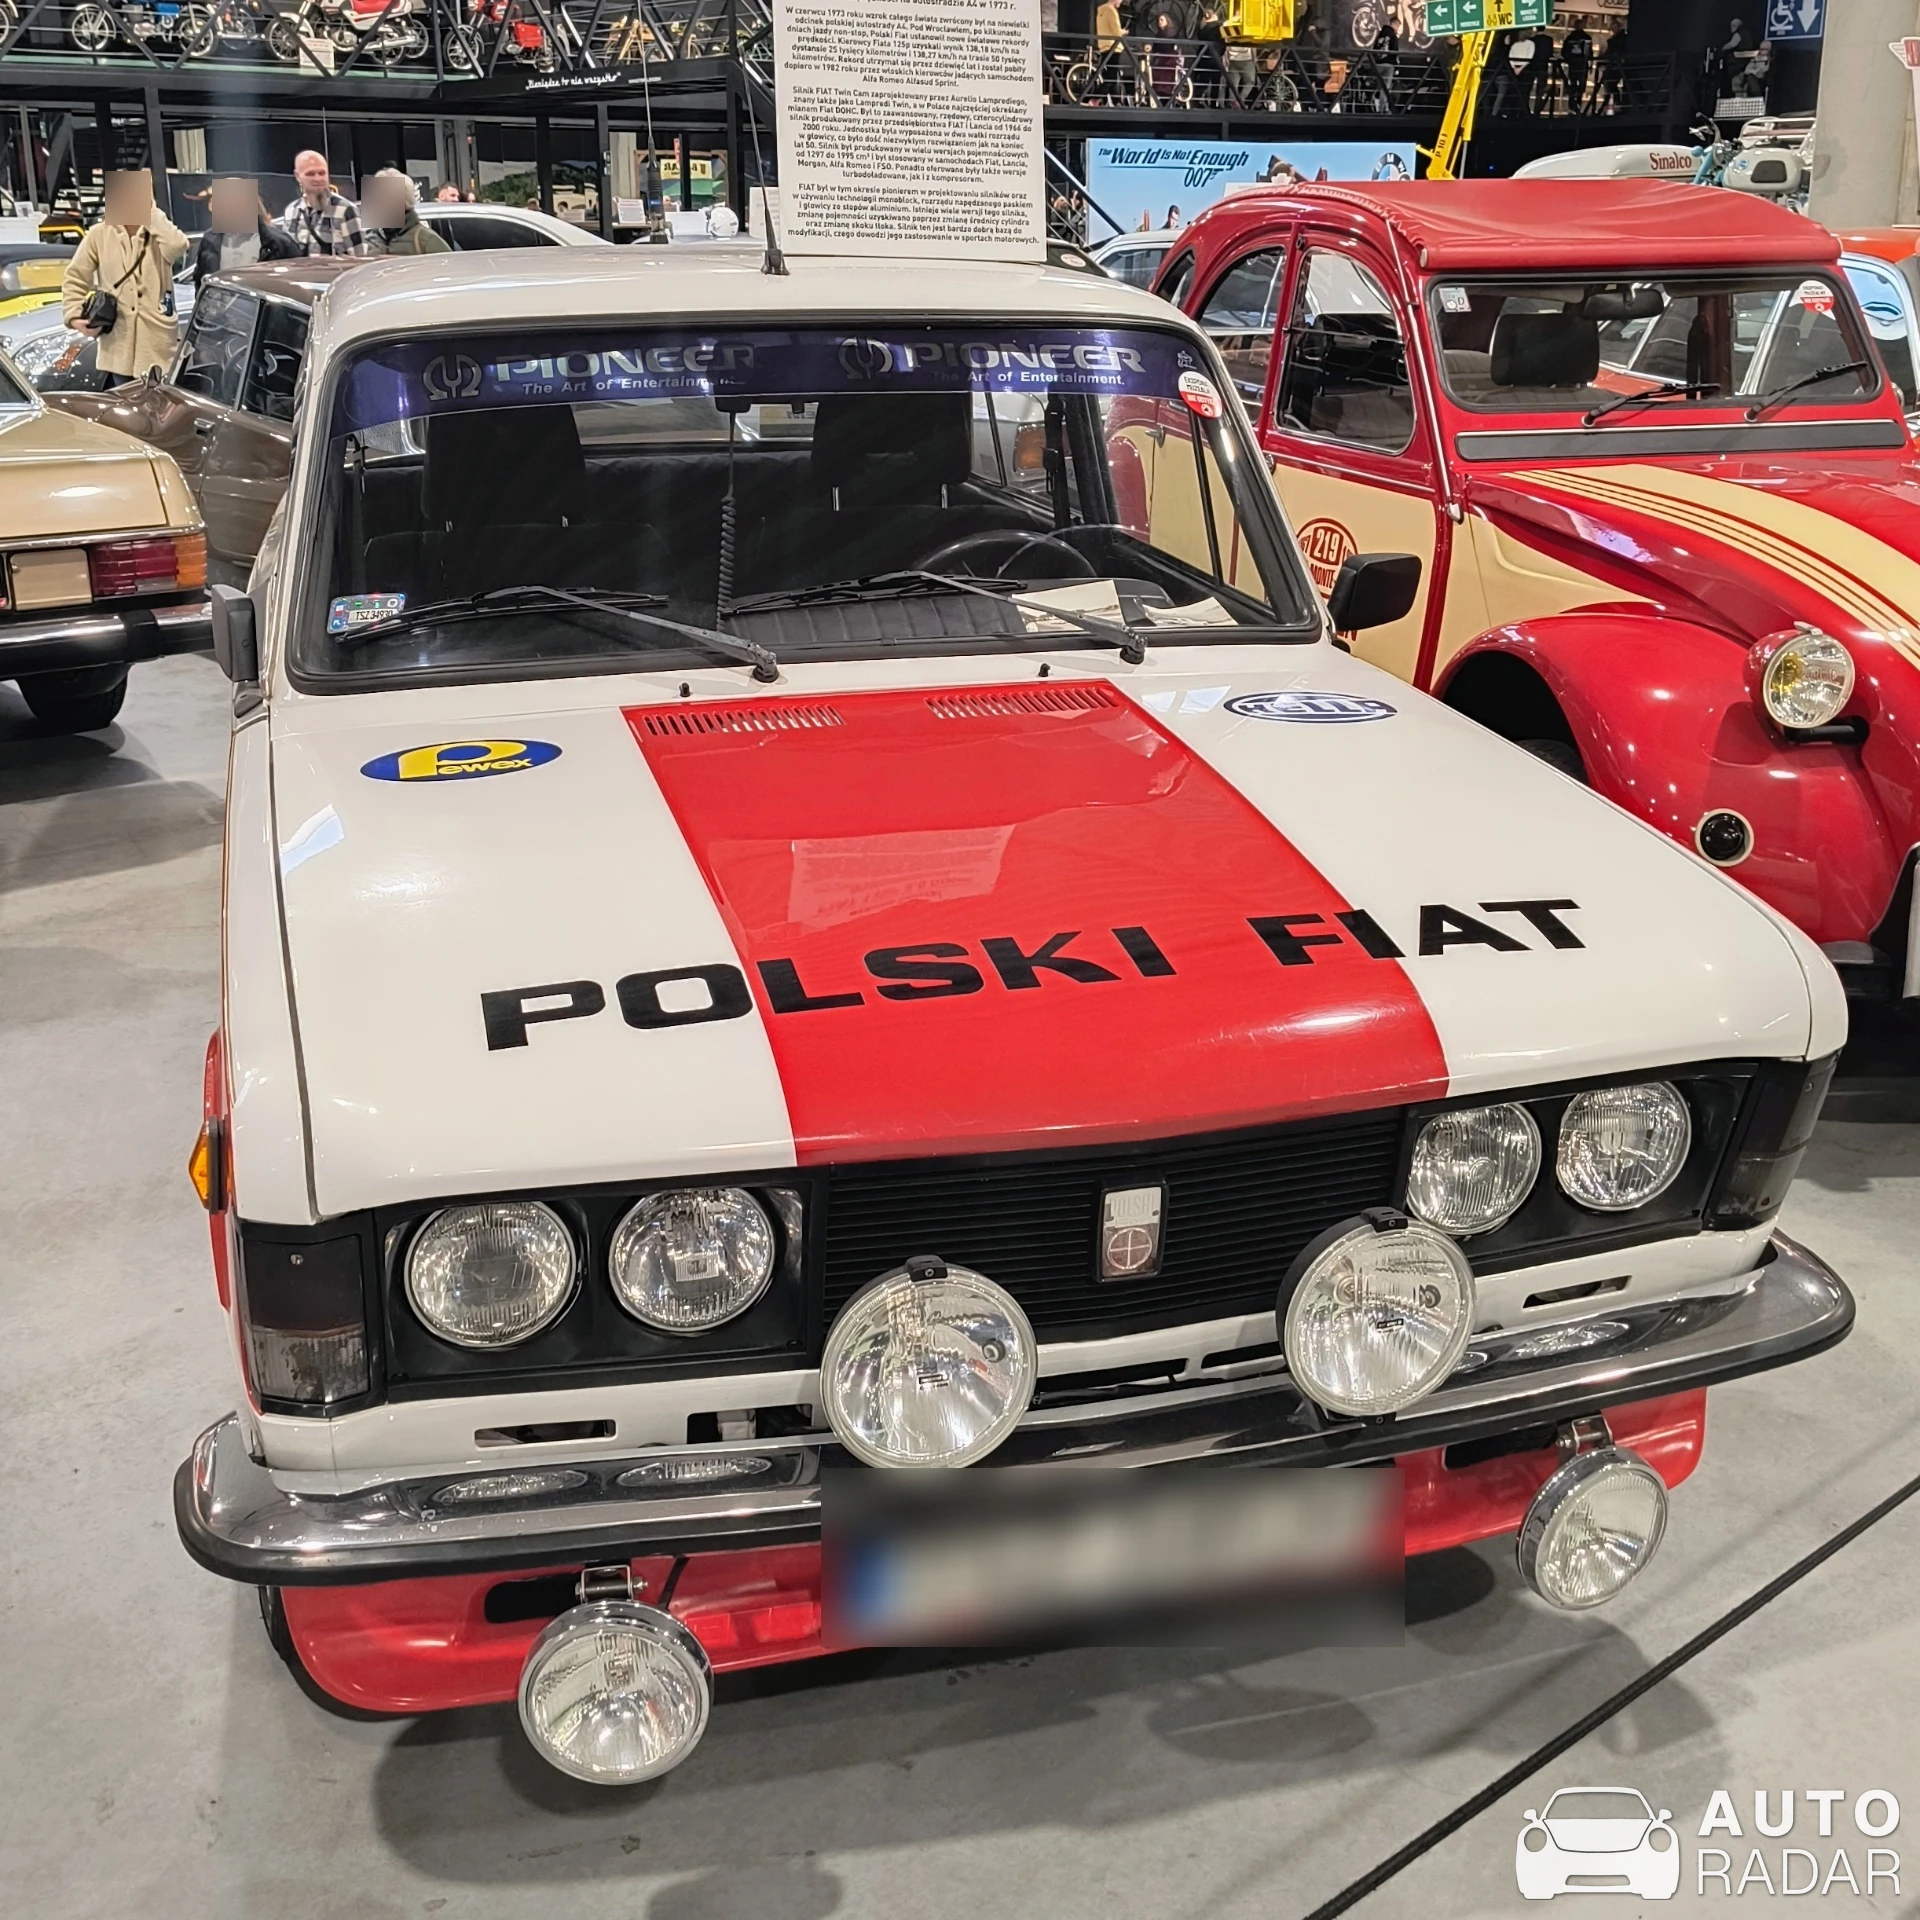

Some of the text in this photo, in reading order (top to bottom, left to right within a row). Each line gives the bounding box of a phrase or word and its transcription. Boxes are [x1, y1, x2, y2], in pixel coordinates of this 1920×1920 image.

[966, 0, 977, 8] A4
[989, 0, 1008, 9] 1973
[794, 16, 824, 24] odcinek
[825, 18, 854, 27] polskiej
[855, 20, 895, 30] autostrady
[983, 28, 1021, 36] kilkunastu
[864, 11, 887, 19] wzrok
[939, 16, 973, 26] zwrócony
[997, 20, 1030, 28] niewielki
[1499, 13, 1513, 25] WC
[812, 27, 832, 35] jazdy
[1001, 38, 1030, 47] rekordy
[837, 37, 871, 47] Kierowcy
[893, 40, 910, 49] 125p
[911, 41, 941, 51] uzyskali
[942, 43, 964, 52] wynik
[783, 61, 812, 70] dopiero
[914, 68, 953, 77] kierowców
[986, 73, 1034, 81] samochodem
[837, 55, 864, 63] Rekord
[1004, 65, 1026, 74] pobity
[870, 90, 928, 101] zaprojektowany
[972, 114, 1033, 124] czterocylindrowy
[1098, 147, 1249, 170] The World Is Not Enough
[1649, 151, 1692, 170] Sinalco
[1184, 167, 1218, 187] 007
[837, 185, 852, 193] tym
[881, 187, 919, 196] pionierem
[927, 189, 979, 198] projektowaniu
[836, 194, 876, 203] technologii
[1002, 201, 1033, 209] paskiem
[868, 213, 910, 222] uzyskiwano
[1000, 218, 1029, 226] cylindra
[961, 234, 992, 243] sportach
[496, 345, 755, 381] PIONEER
[904, 341, 1146, 373] PIONEER
[523, 382, 553, 395] The
[561, 380, 587, 393] Art
[595, 378, 614, 391] of
[967, 370, 990, 382] Art
[997, 370, 1013, 382] of
[1019, 371, 1125, 386] Entertainment.
[1313, 528, 1340, 562] 219
[398, 740, 533, 780] Pewex
[480, 898, 1587, 1051] POLSKI FIAT
